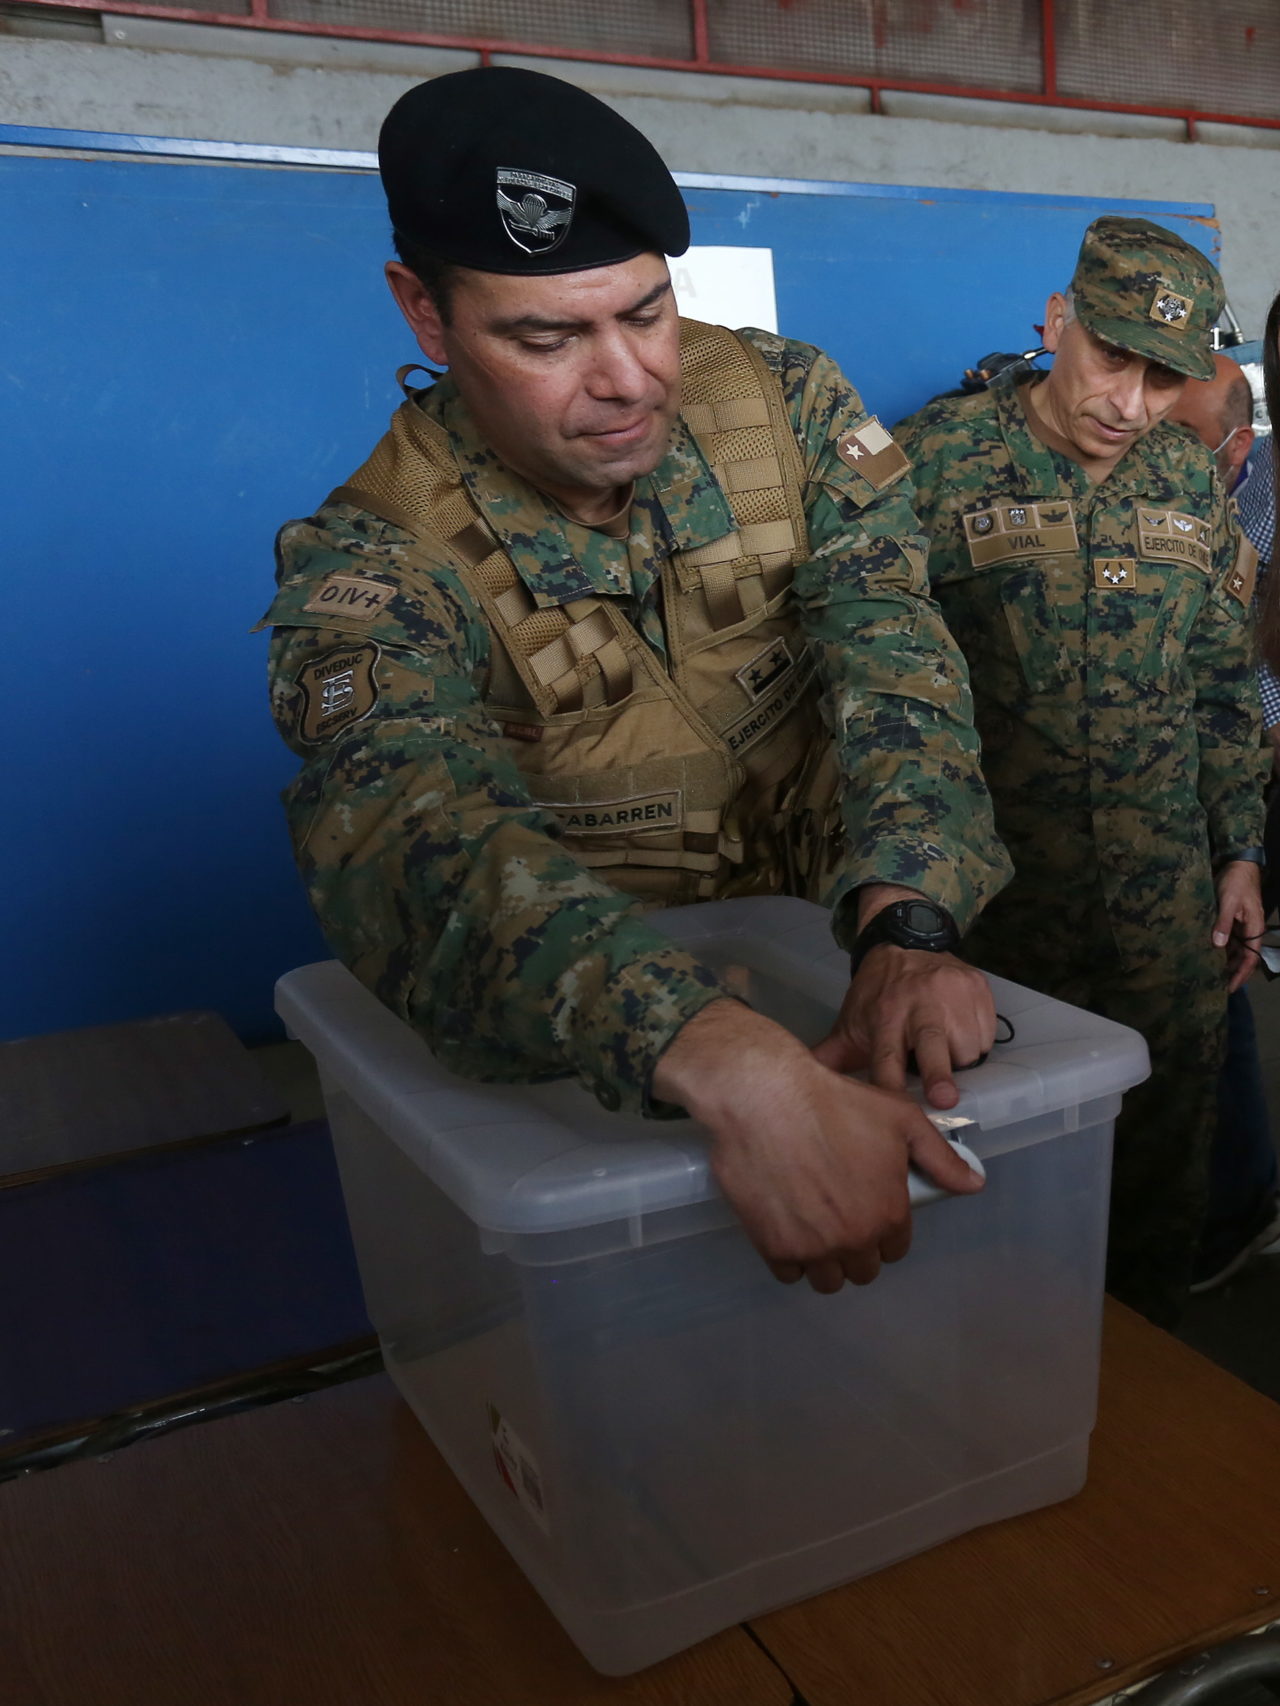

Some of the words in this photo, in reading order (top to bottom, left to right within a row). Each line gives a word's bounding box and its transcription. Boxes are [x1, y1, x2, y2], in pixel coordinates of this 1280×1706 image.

[1007, 535, 1045, 550] VIAL
[1144, 536, 1185, 554] EJERCITO
[1188, 543, 1197, 558] DE
[314, 653, 363, 680] DIVEDUC
[728, 699, 783, 750] EJERCITO
[558, 802, 673, 827] ABARREN
